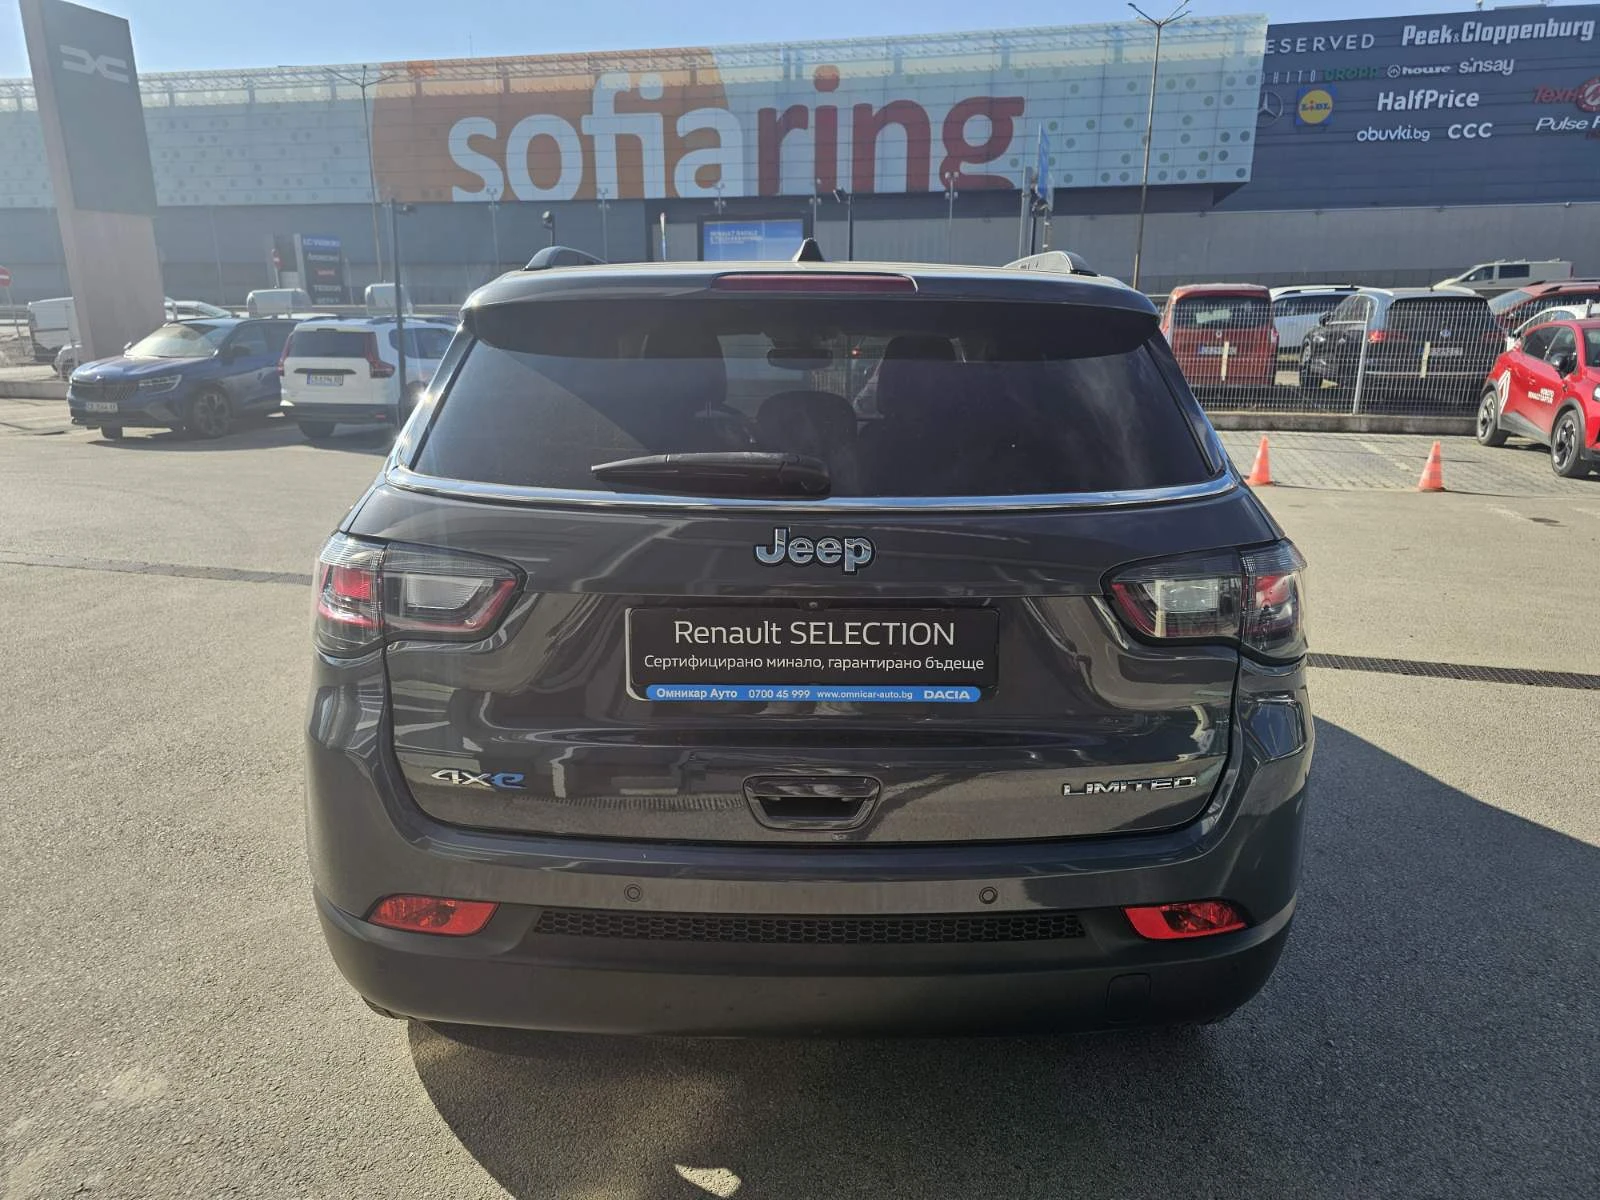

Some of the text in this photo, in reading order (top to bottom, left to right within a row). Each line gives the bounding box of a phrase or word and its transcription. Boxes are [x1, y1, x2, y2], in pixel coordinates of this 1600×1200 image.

[1264, 34, 1375, 54] ESERVED
[1459, 57, 1514, 75] sinsay
[1378, 90, 1479, 111] HalfPrice
[448, 64, 1025, 202] sofiaring
[1448, 123, 1493, 139] CCC
[1536, 116, 1589, 131] Pulse
[1357, 125, 1430, 142] obuvki.bg
[754, 527, 875, 573] Jeep
[674, 620, 955, 646] Renault SELECTION
[644, 655, 985, 670] Сертифицирано минало, гарантирано бъдеще
[656, 687, 971, 700] Омникар Ауто 0700 45 999 www.omnicar-auto.bg DACIA
[1063, 776, 1196, 796] LIMITED
